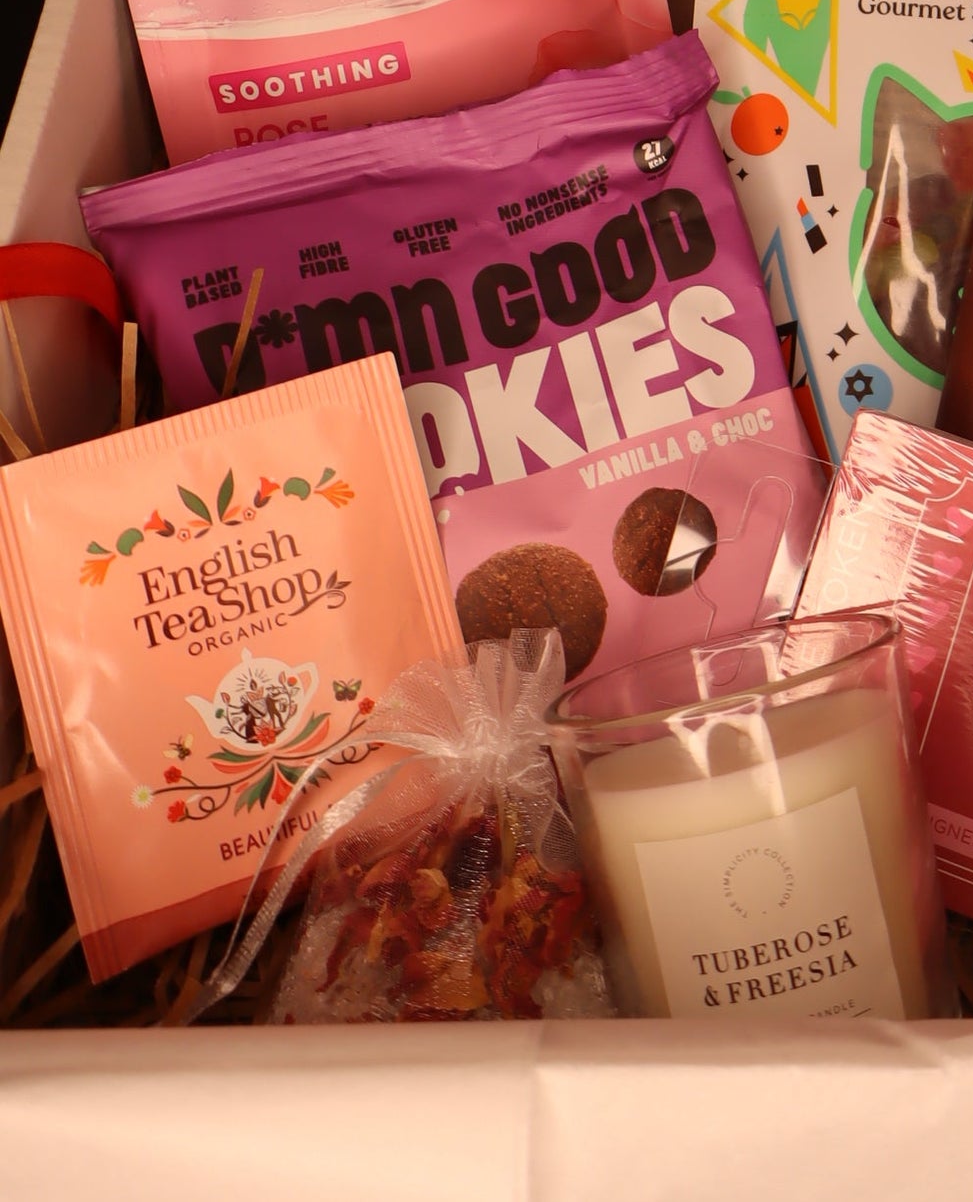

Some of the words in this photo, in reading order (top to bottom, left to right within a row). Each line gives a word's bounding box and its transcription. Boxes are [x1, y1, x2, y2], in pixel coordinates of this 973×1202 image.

[218, 54, 399, 104] SOOTHING
[496, 200, 524, 223] NO
[525, 165, 609, 212] NONSENSE
[504, 185, 609, 237] INGREDIENTS
[298, 241, 342, 263] HIGH
[393, 217, 458, 244] GLUTEN
[408, 237, 452, 258] FREE
[181, 265, 240, 294] PLANT
[299, 256, 350, 280] FIBRE
[471, 187, 717, 349] GOOD
[184, 281, 243, 310] BASED
[577, 437, 685, 490] VANILLA
[688, 429, 708, 454] &
[713, 406, 775, 448] CHOC
[136, 528, 301, 607] English
[133, 603, 216, 651] Tea
[187, 612, 289, 657] ORGANIC
[723, 847, 760, 898] SIMPLICITY
[763, 847, 795, 909] COLLECTION
[691, 914, 853, 976] TUBEROSE
[809, 999, 856, 1019] ANDLE
